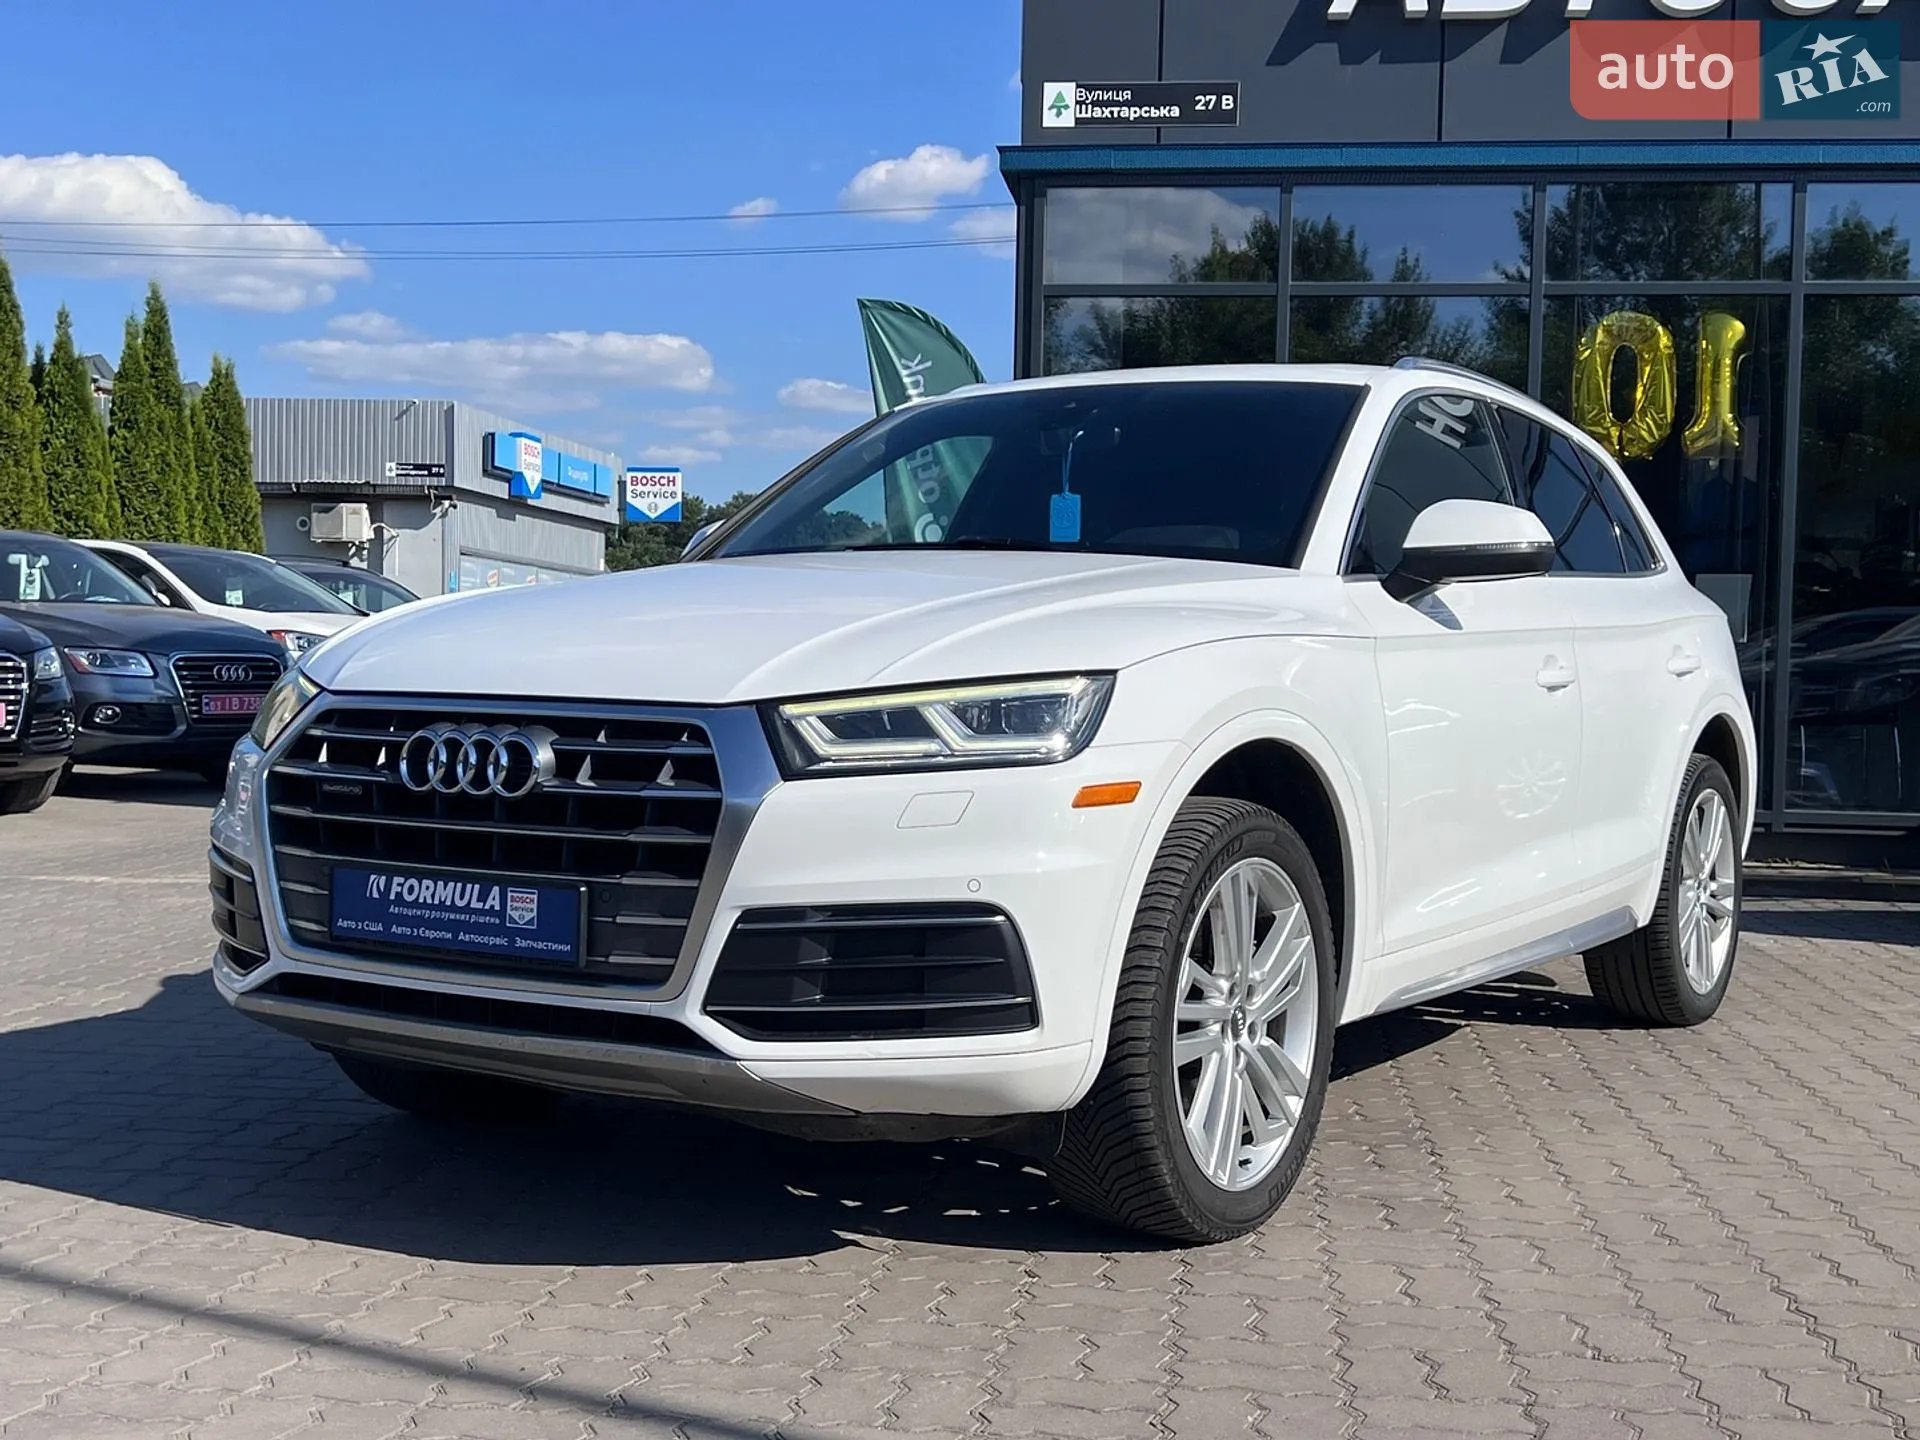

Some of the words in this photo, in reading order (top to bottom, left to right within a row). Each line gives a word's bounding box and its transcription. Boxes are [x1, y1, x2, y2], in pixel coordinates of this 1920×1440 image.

[1076, 88, 1132, 103] Вулиця
[1194, 95, 1217, 111] 27
[1221, 95, 1234, 110] В
[1076, 104, 1180, 121] Шахтарська
[630, 475, 676, 487] BOSCH
[630, 488, 678, 500] Service
[389, 876, 500, 911] FORMULA
[510, 894, 535, 904] BOSCH
[510, 904, 535, 914] Service
[337, 918, 357, 928] Авто
[363, 921, 383, 931] США
[390, 924, 411, 935] Авто
[419, 926, 453, 941] Європи
[458, 931, 509, 946] Автосервіс
[514, 937, 571, 952] Запчастини
